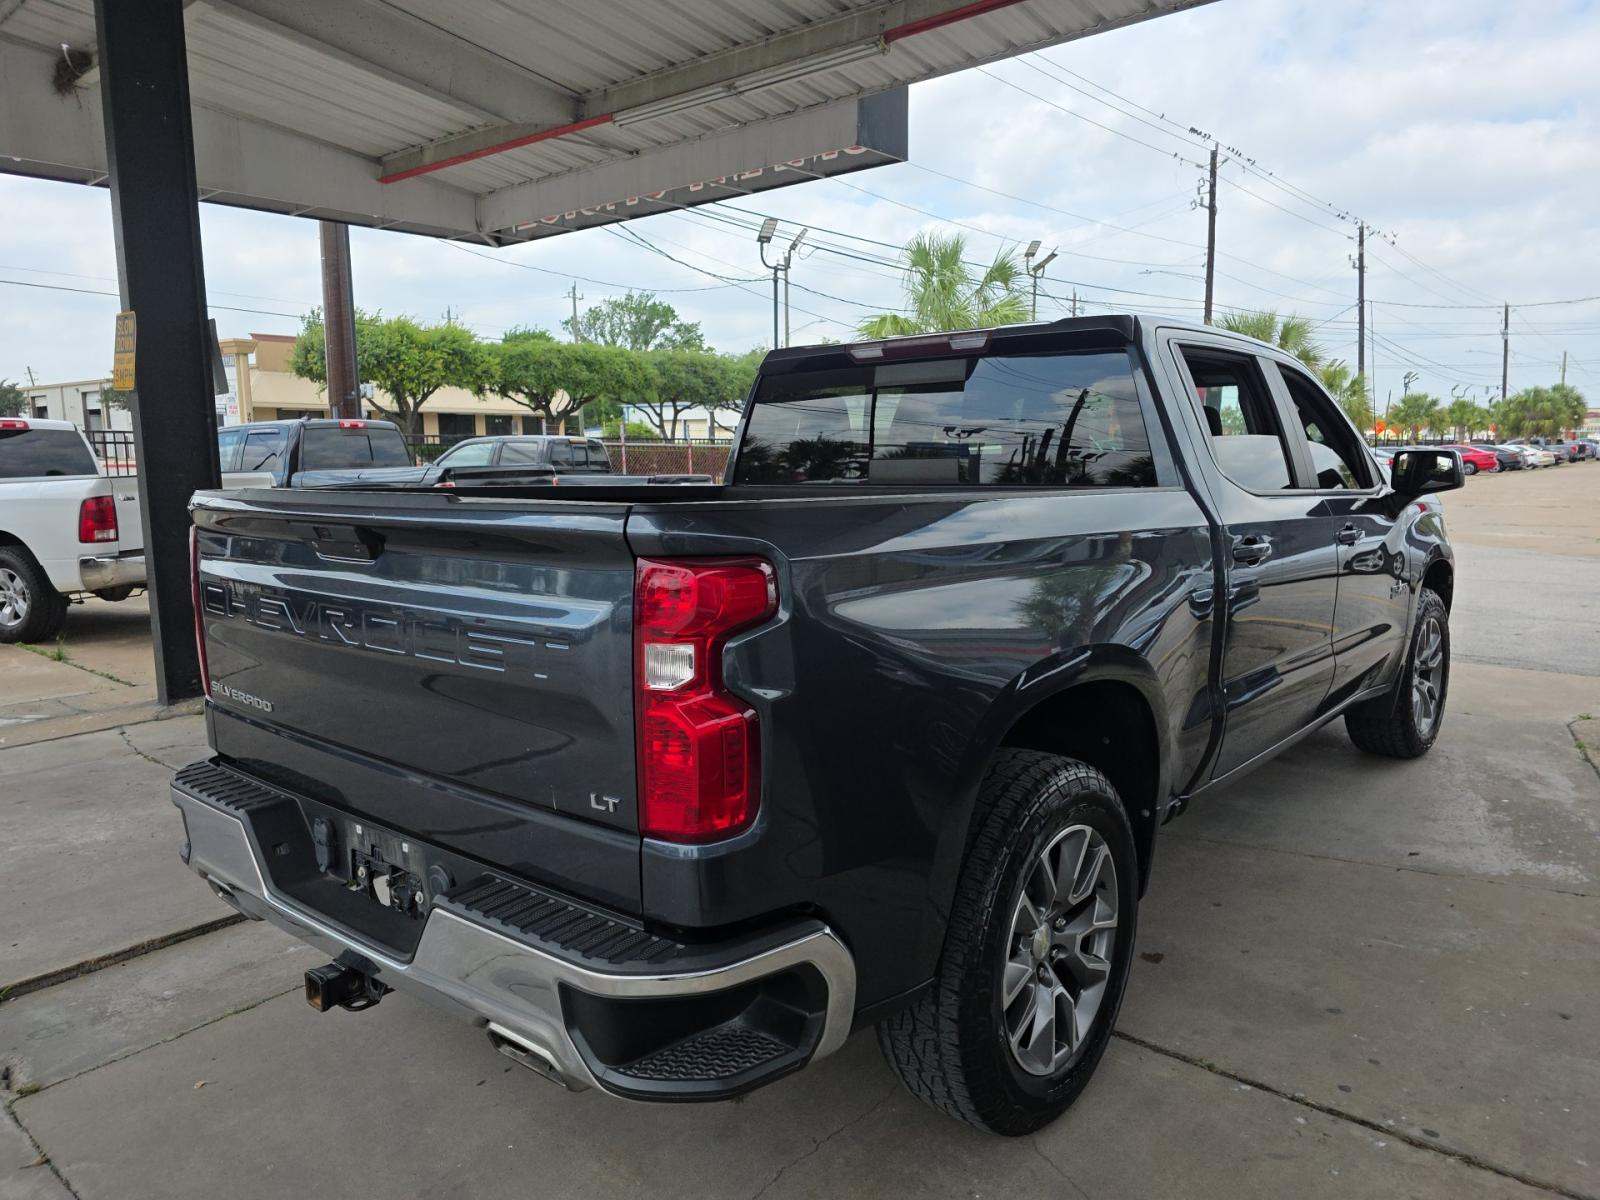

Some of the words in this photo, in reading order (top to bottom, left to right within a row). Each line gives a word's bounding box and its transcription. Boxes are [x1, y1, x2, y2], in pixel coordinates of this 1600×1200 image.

[117, 319, 135, 336] SLOW
[205, 582, 572, 680] CHEVROLET
[211, 681, 273, 712] SILVERADO
[590, 793, 620, 813] LT
